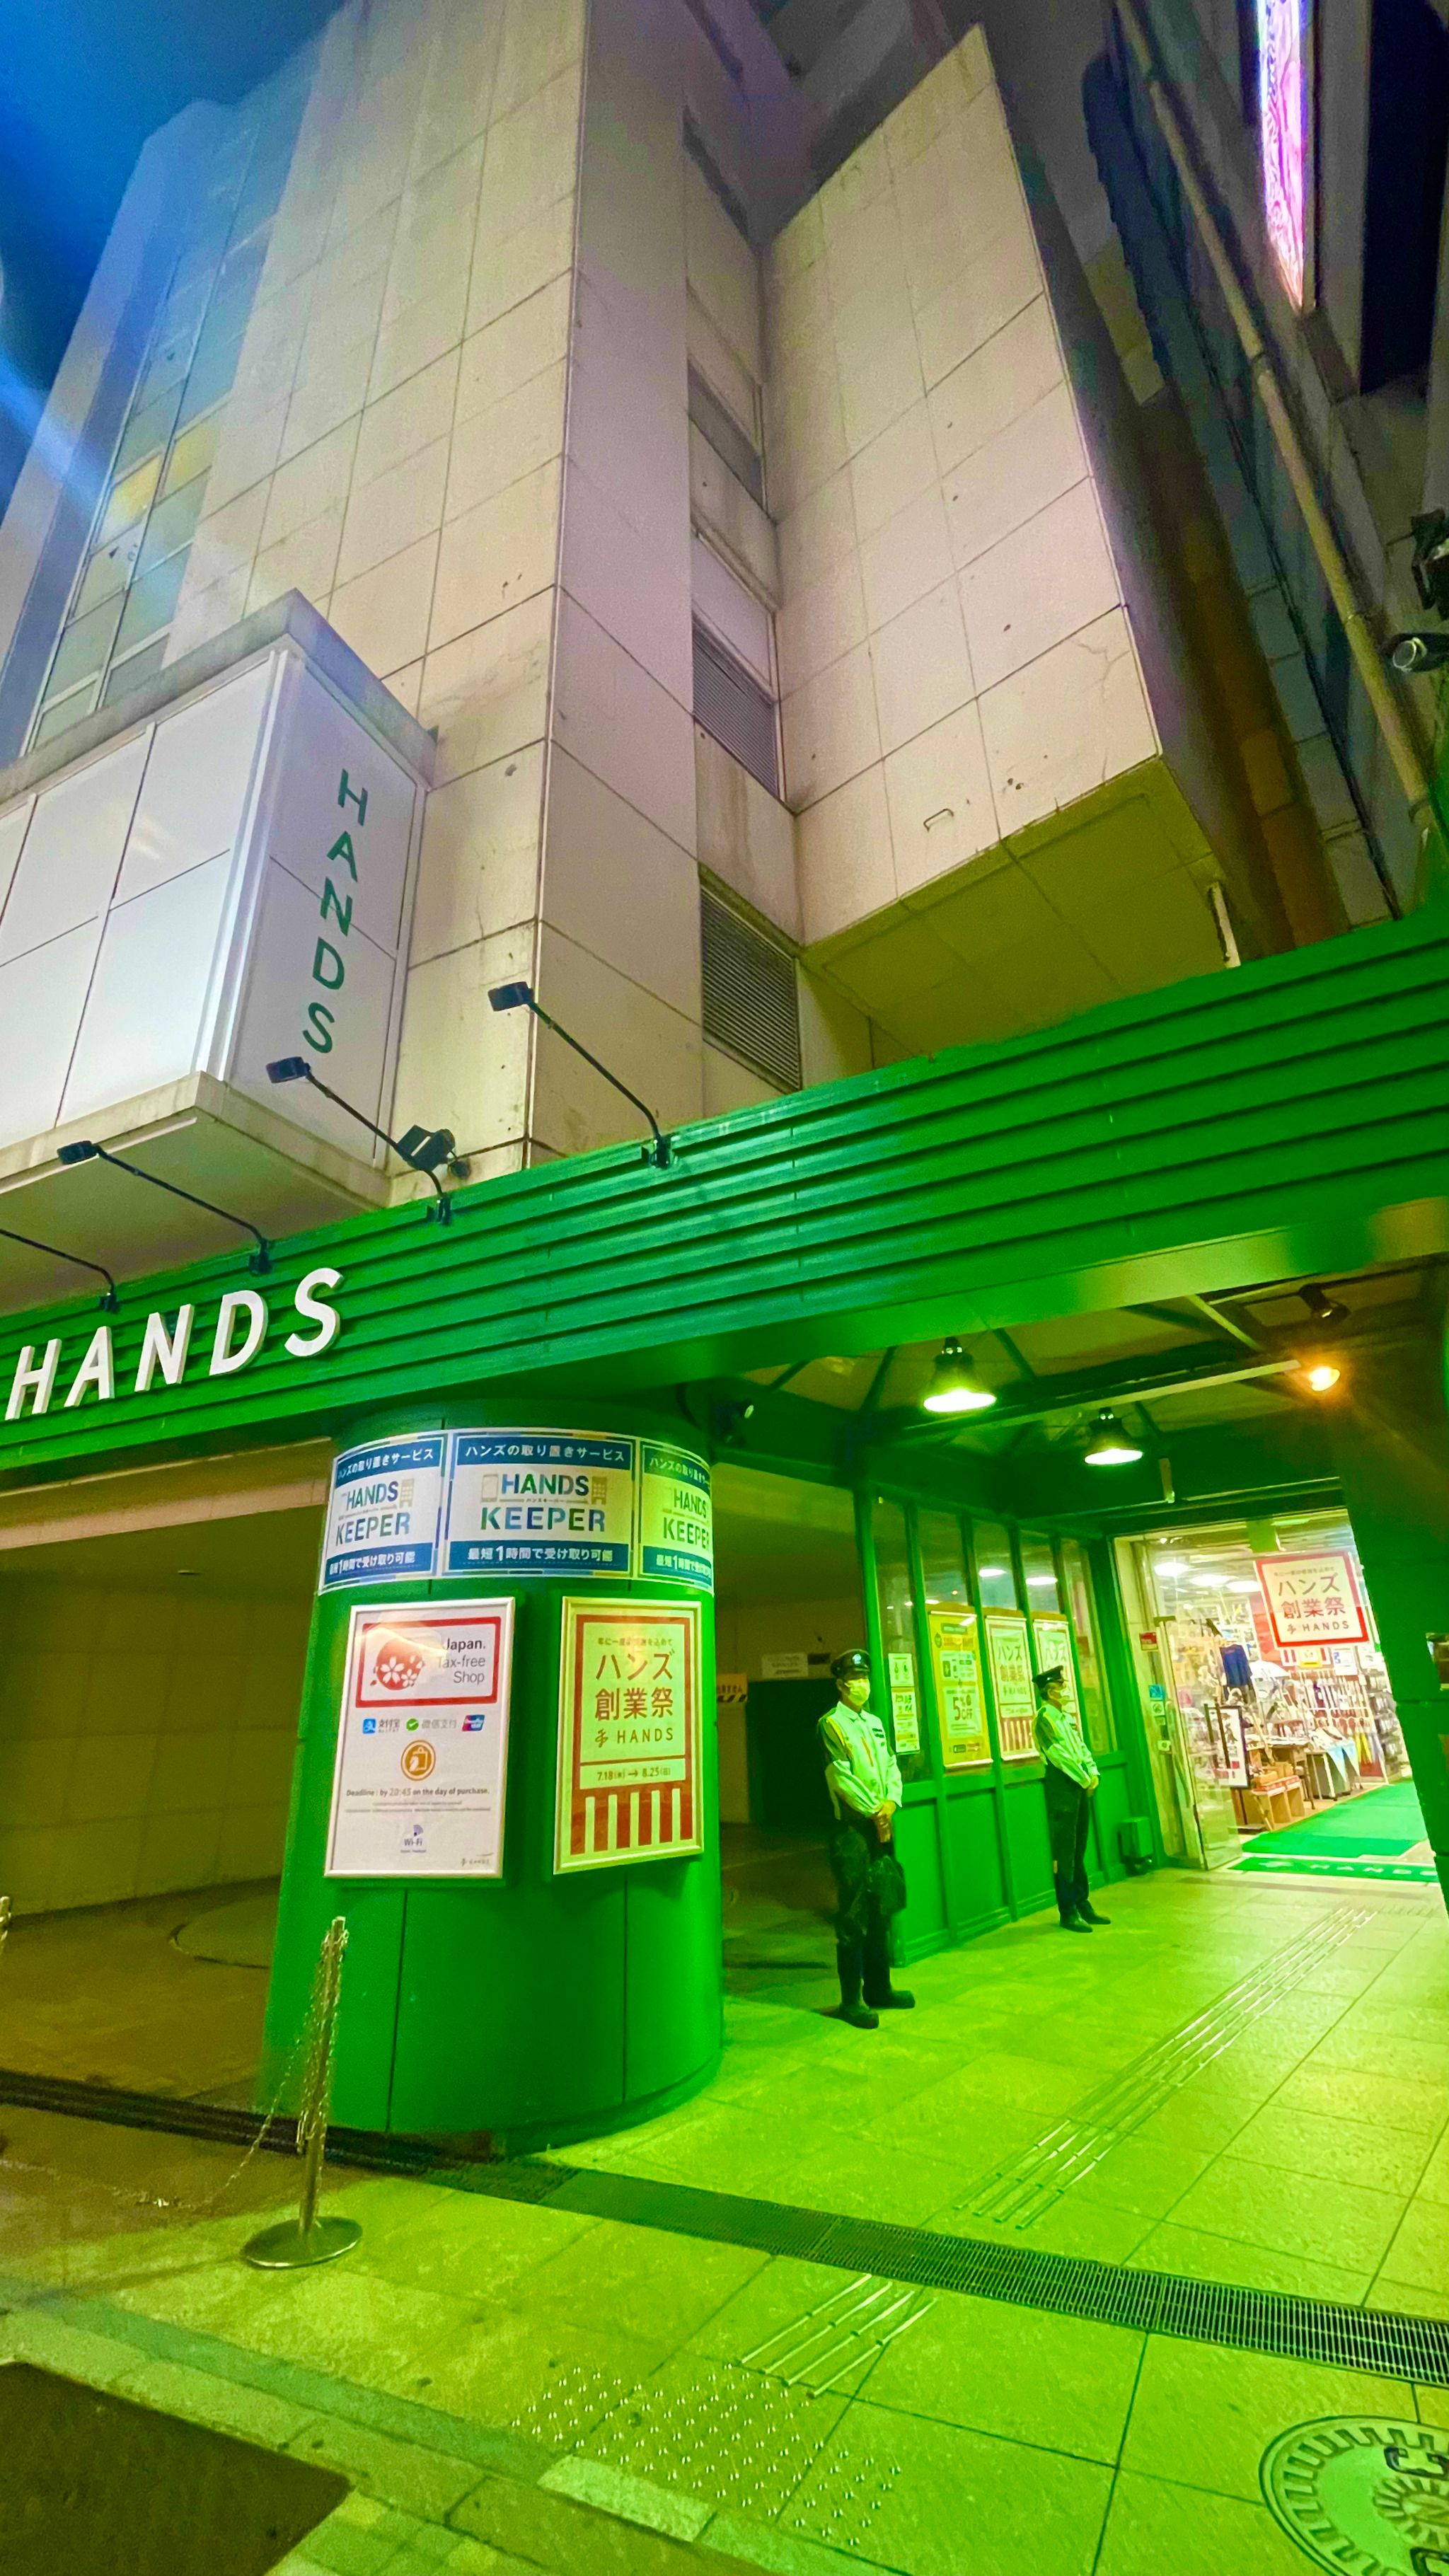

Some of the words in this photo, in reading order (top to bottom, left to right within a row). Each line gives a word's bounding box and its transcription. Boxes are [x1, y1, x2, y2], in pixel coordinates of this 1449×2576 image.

[303, 768, 368, 1053] HANDS
[6, 1267, 345, 1421] HANDS
[465, 1443, 625, 1462] ハンズの取り置きサービス
[345, 1481, 399, 1511] HANDS
[500, 1473, 589, 1497] HANDS
[674, 1488, 707, 1519] HANDS
[335, 1511, 411, 1547] KEEPER
[480, 1506, 606, 1533] KEEPER
[467, 1545, 613, 1563] 最短1時間で受け取り可能
[1278, 1572, 1341, 1597] ハンズ
[1281, 1596, 1346, 1619] 創業祭
[1302, 1620, 1349, 1632] HANDS
[437, 1655, 486, 1669] Tax-free
[596, 1648, 676, 1680] ハンズ
[998, 1644, 1023, 1661] ハンズ
[454, 1670, 485, 1685] Shop
[595, 1687, 674, 1721] 創業祭
[617, 1727, 674, 1744] HANDS
[380, 1789, 388, 1798] by
[434, 1787, 447, 1796] day
